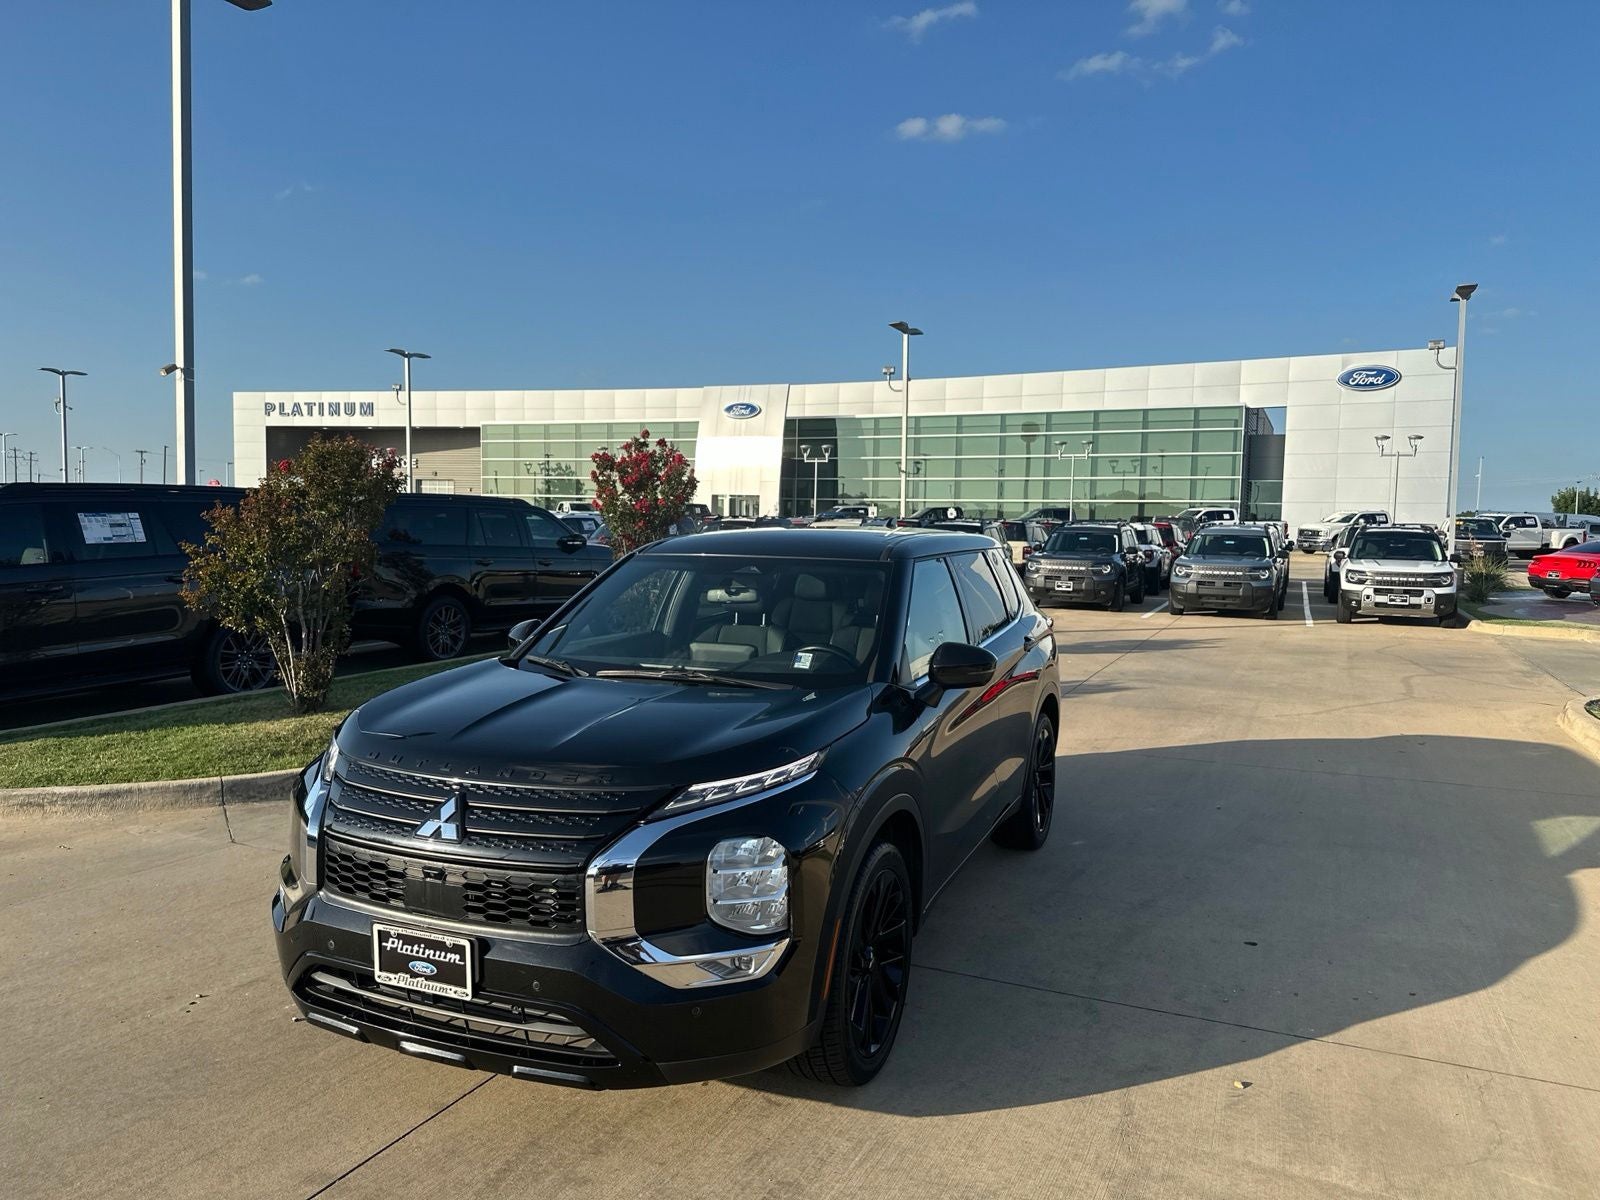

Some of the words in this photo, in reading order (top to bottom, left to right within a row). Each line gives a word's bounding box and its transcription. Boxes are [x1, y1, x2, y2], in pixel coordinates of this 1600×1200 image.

[1349, 371, 1386, 385] Ford
[264, 402, 374, 417] PLATINUM
[367, 751, 614, 785] OUTLANDER
[382, 937, 465, 965] Platinum
[396, 974, 449, 994] Platinum
